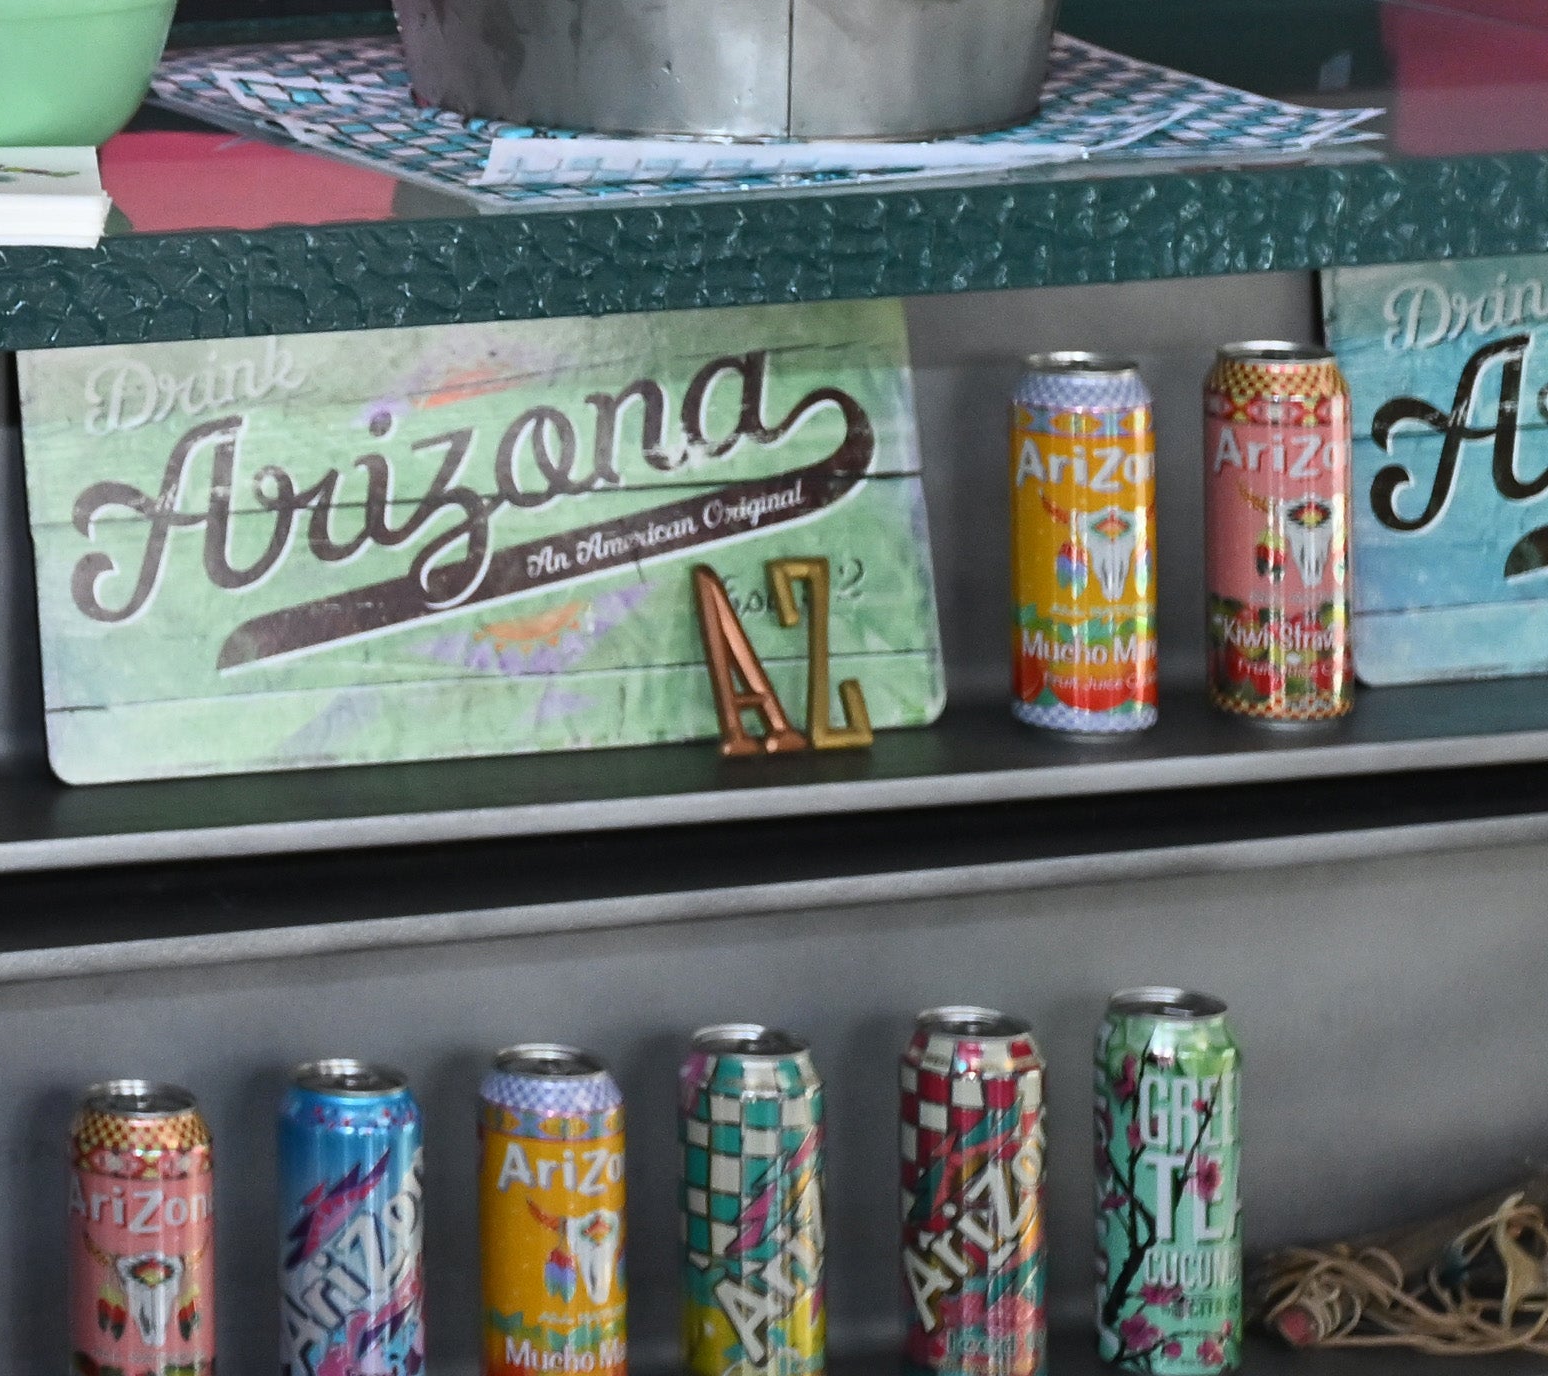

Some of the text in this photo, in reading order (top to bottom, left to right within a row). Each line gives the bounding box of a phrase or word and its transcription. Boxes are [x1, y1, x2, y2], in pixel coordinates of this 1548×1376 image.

[85, 335, 306, 436] Drink
[70, 350, 786, 623] Arizona
[527, 479, 805, 579] An American Original
[1021, 629, 1108, 665] Mucho
[69, 1167, 212, 1237] AriZon
[497, 1142, 625, 1196] AriZo
